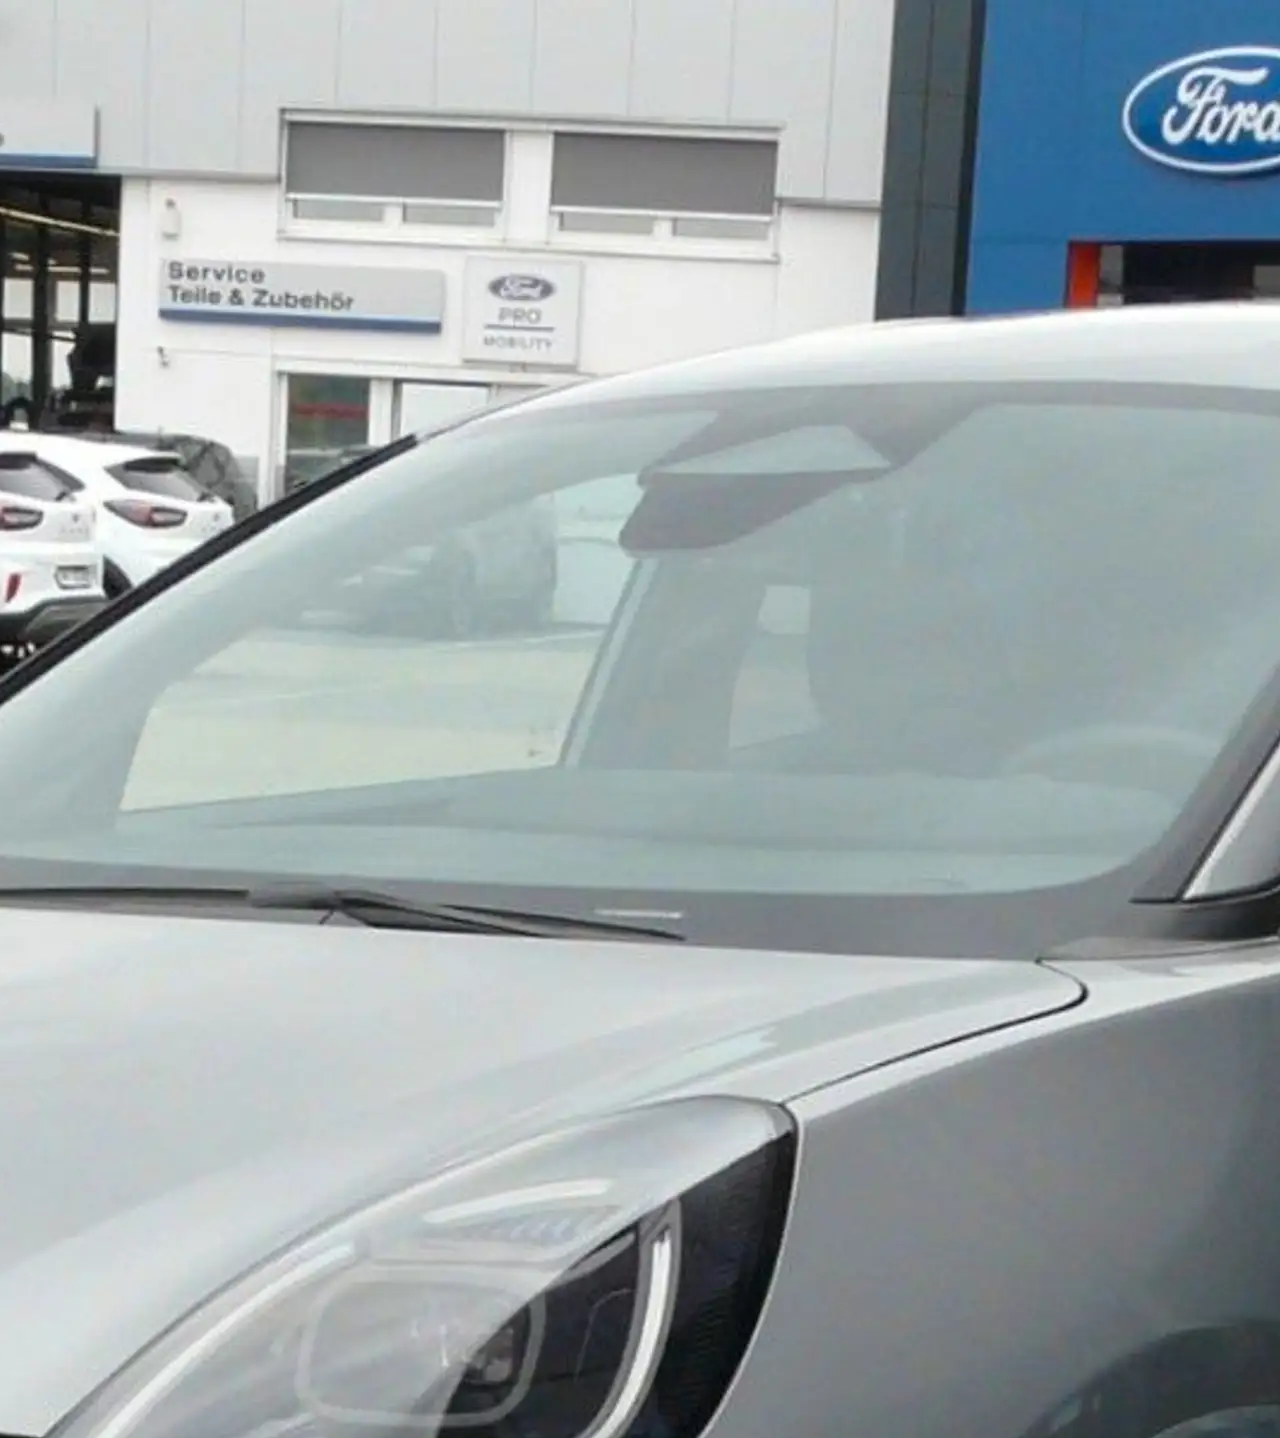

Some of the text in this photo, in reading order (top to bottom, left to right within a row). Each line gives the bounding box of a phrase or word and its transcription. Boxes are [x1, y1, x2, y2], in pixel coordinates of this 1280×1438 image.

[168, 260, 266, 284] Service
[169, 284, 355, 312] Teile & Zubehör
[498, 306, 543, 326] PRO
